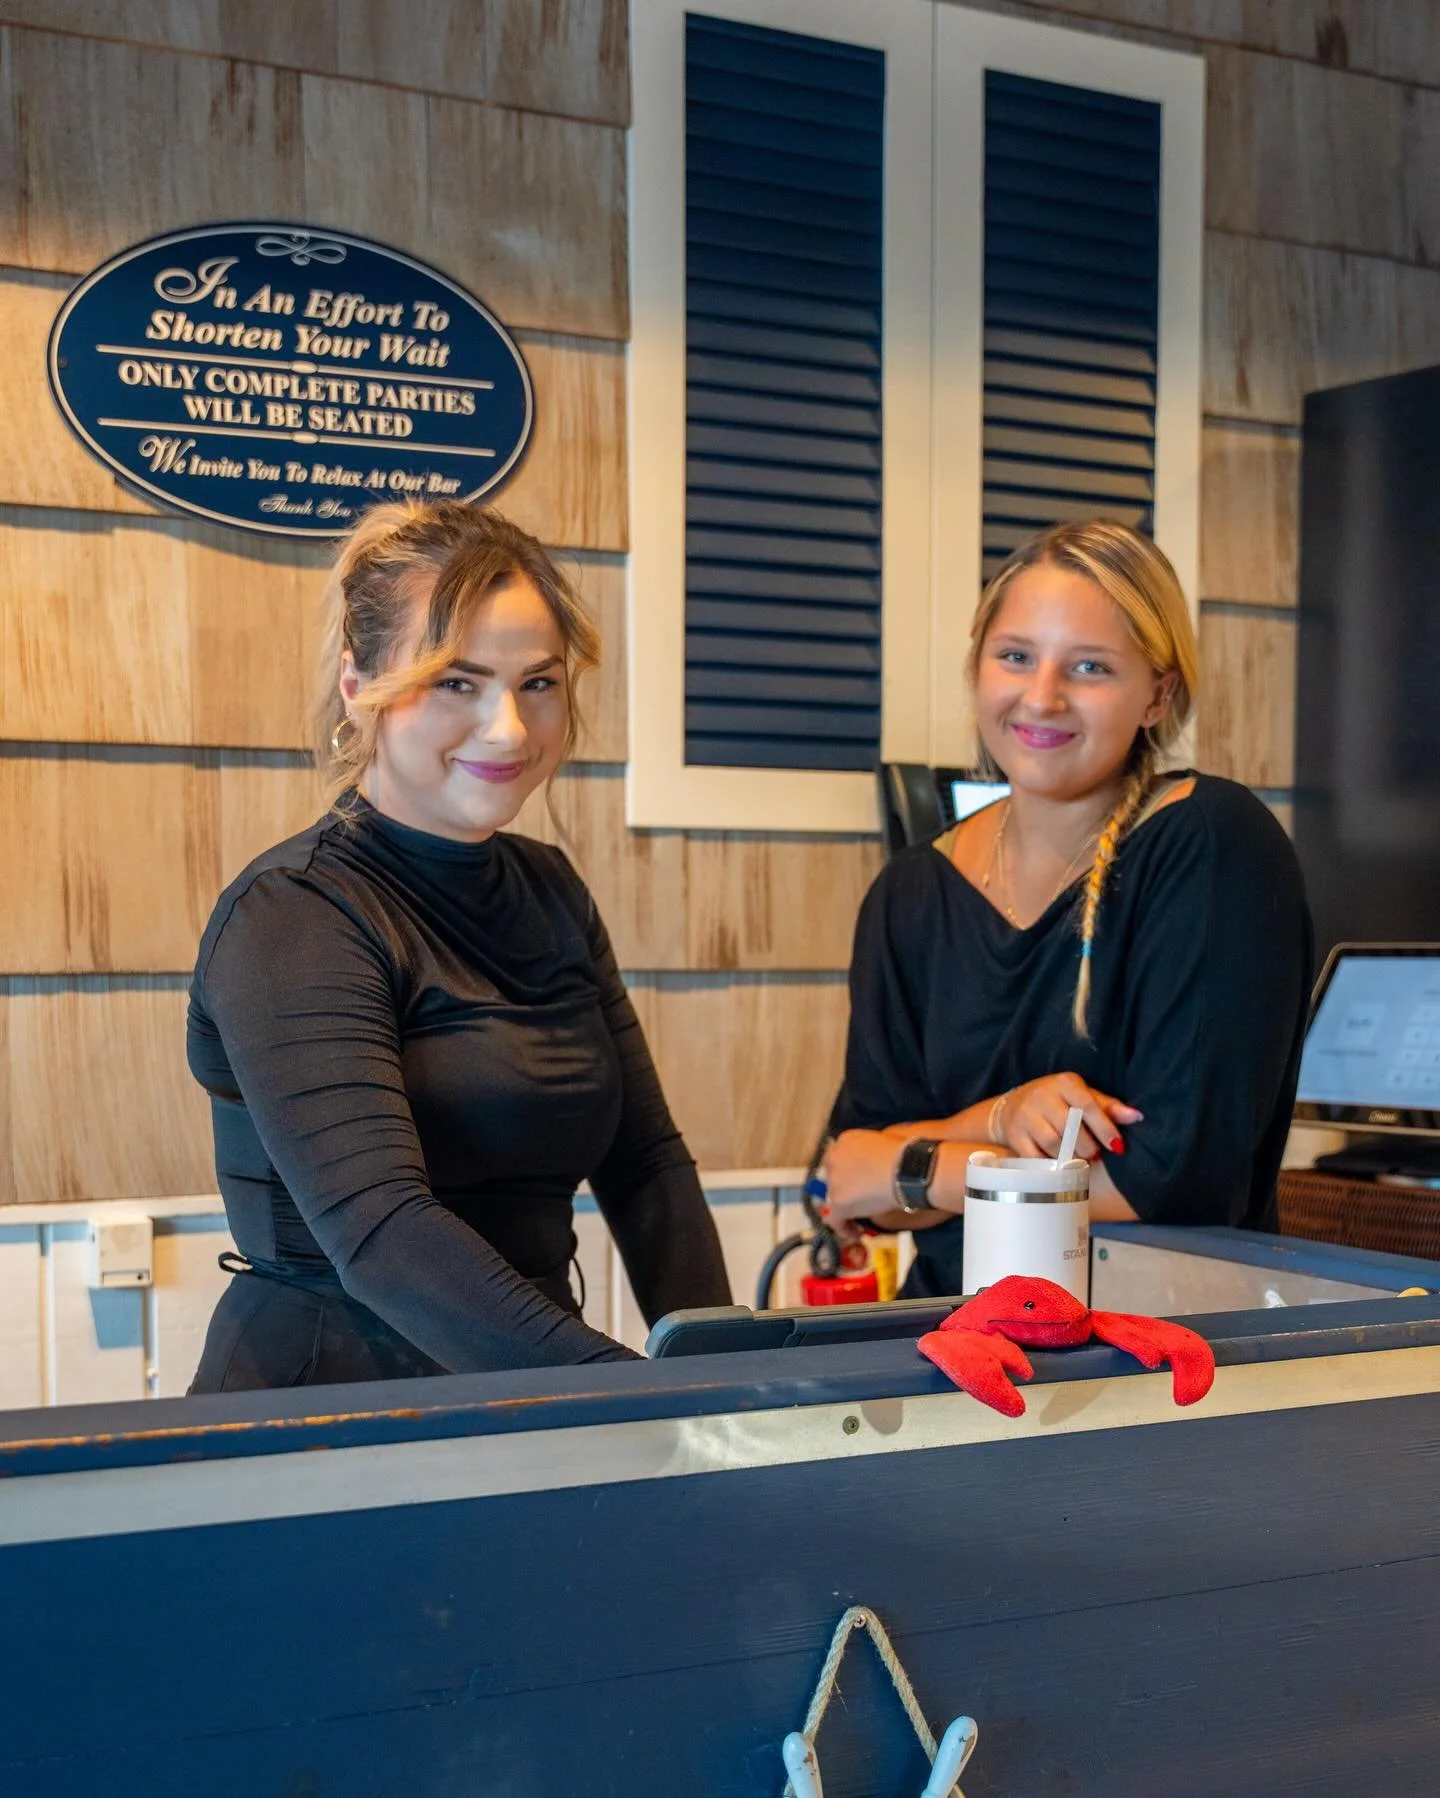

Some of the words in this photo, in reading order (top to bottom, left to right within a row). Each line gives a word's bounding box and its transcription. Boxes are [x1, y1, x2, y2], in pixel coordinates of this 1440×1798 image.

[154, 256, 240, 309] In
[242, 283, 296, 315] An
[304, 289, 404, 328] Effort
[412, 300, 450, 332] To
[145, 309, 283, 350] Shorten
[295, 324, 371, 359] Your
[379, 332, 450, 368] Wait
[118, 359, 200, 390] ONLY
[204, 367, 361, 405] COMPLETE
[367, 382, 476, 415] PARTIES
[183, 394, 261, 425] WILL
[266, 401, 303, 429] BE
[308, 405, 413, 437] SEATED
[138, 434, 197, 475] We
[188, 454, 244, 479] Invite
[247, 458, 281, 481] You
[285, 460, 308, 483] To
[310, 463, 363, 487] Relax
[364, 467, 387, 489] At
[388, 469, 425, 492] Our
[427, 472, 461, 494] Bar
[258, 493, 313, 516] Thank
